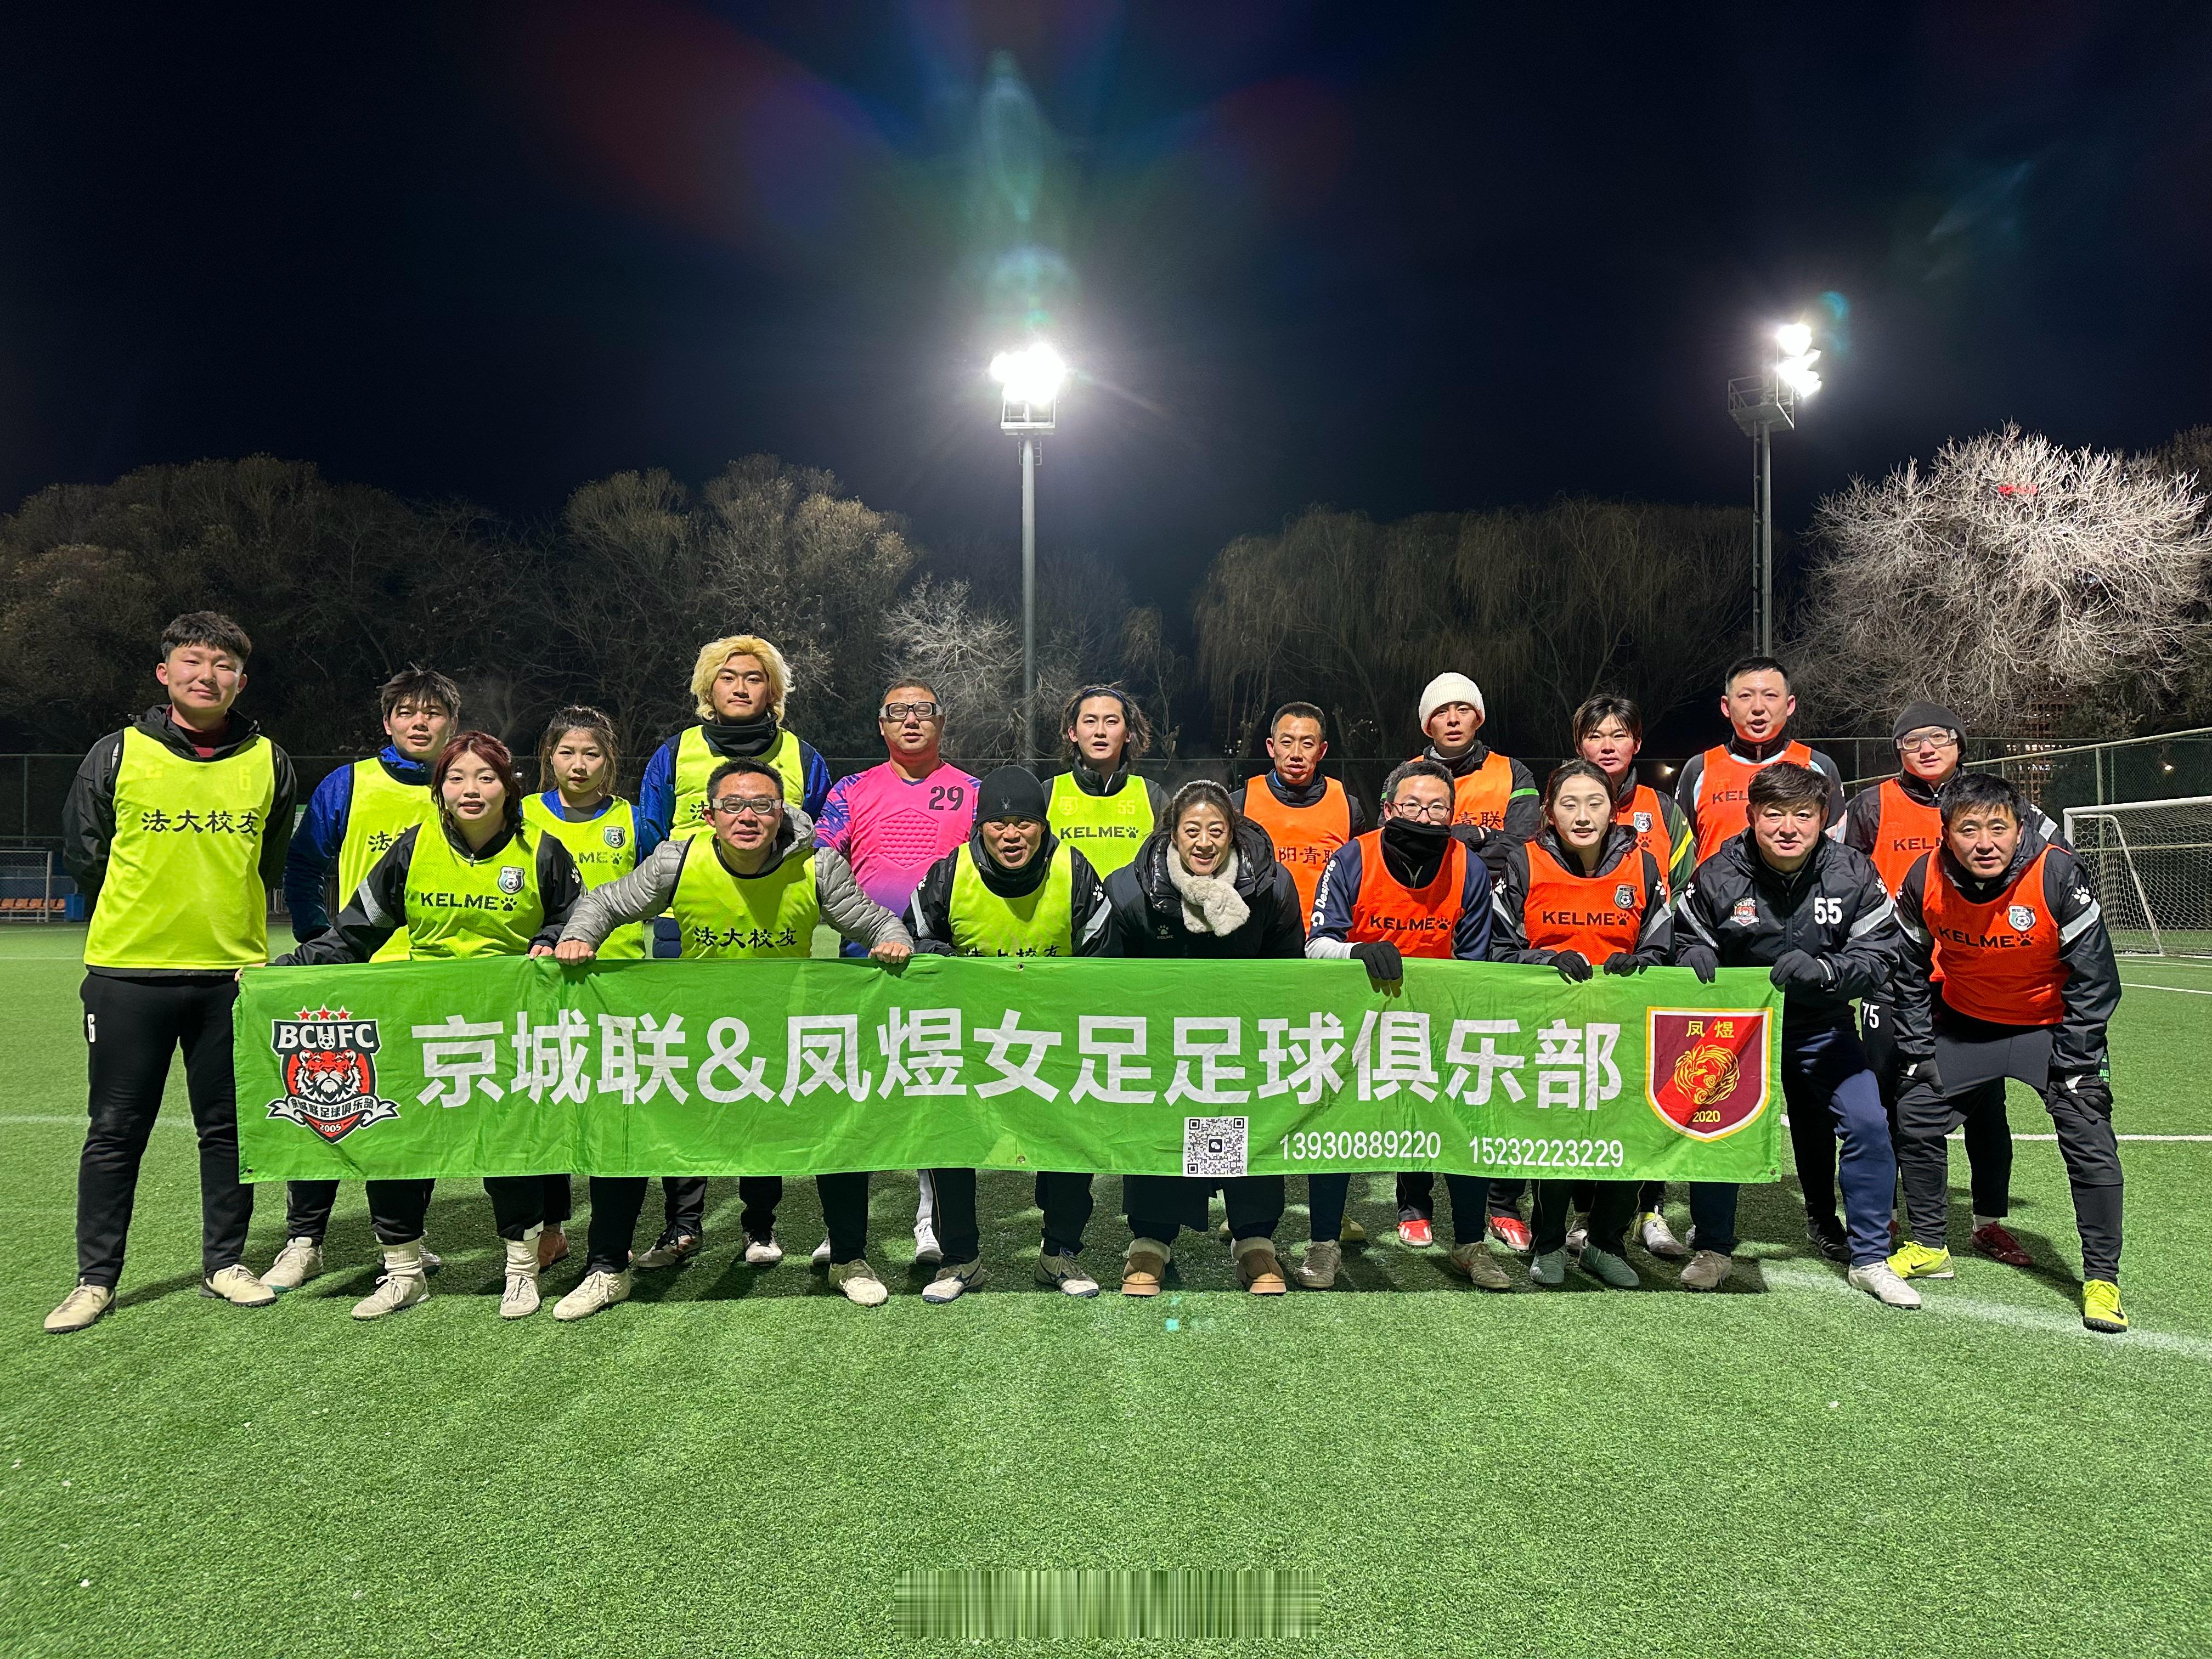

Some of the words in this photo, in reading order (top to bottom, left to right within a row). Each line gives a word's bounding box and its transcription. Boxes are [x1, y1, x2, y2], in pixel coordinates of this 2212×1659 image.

[929, 786, 964, 811] 29
[142, 809, 258, 837] 法大校友
[1060, 826, 1125, 839] KELME
[1314, 860, 1336, 909] Desporte
[420, 893, 499, 910] KELME
[1814, 897, 1843, 924] 55
[1370, 915, 1436, 931] KELME
[1542, 911, 1615, 926] KELME
[693, 927, 798, 949] 法大校友
[1938, 926, 2015, 948] KELME
[1862, 1002, 1880, 1029] 75
[278, 1024, 374, 1049] BCUFC
[411, 1007, 1622, 1110] 京城联&凤煜女足足球俱乐部
[1692, 1110, 1720, 1122] 2020
[319, 1124, 342, 1132] 2005
[1279, 1130, 1441, 1160] 13930889220
[1469, 1136, 1623, 1167] 15232223229
